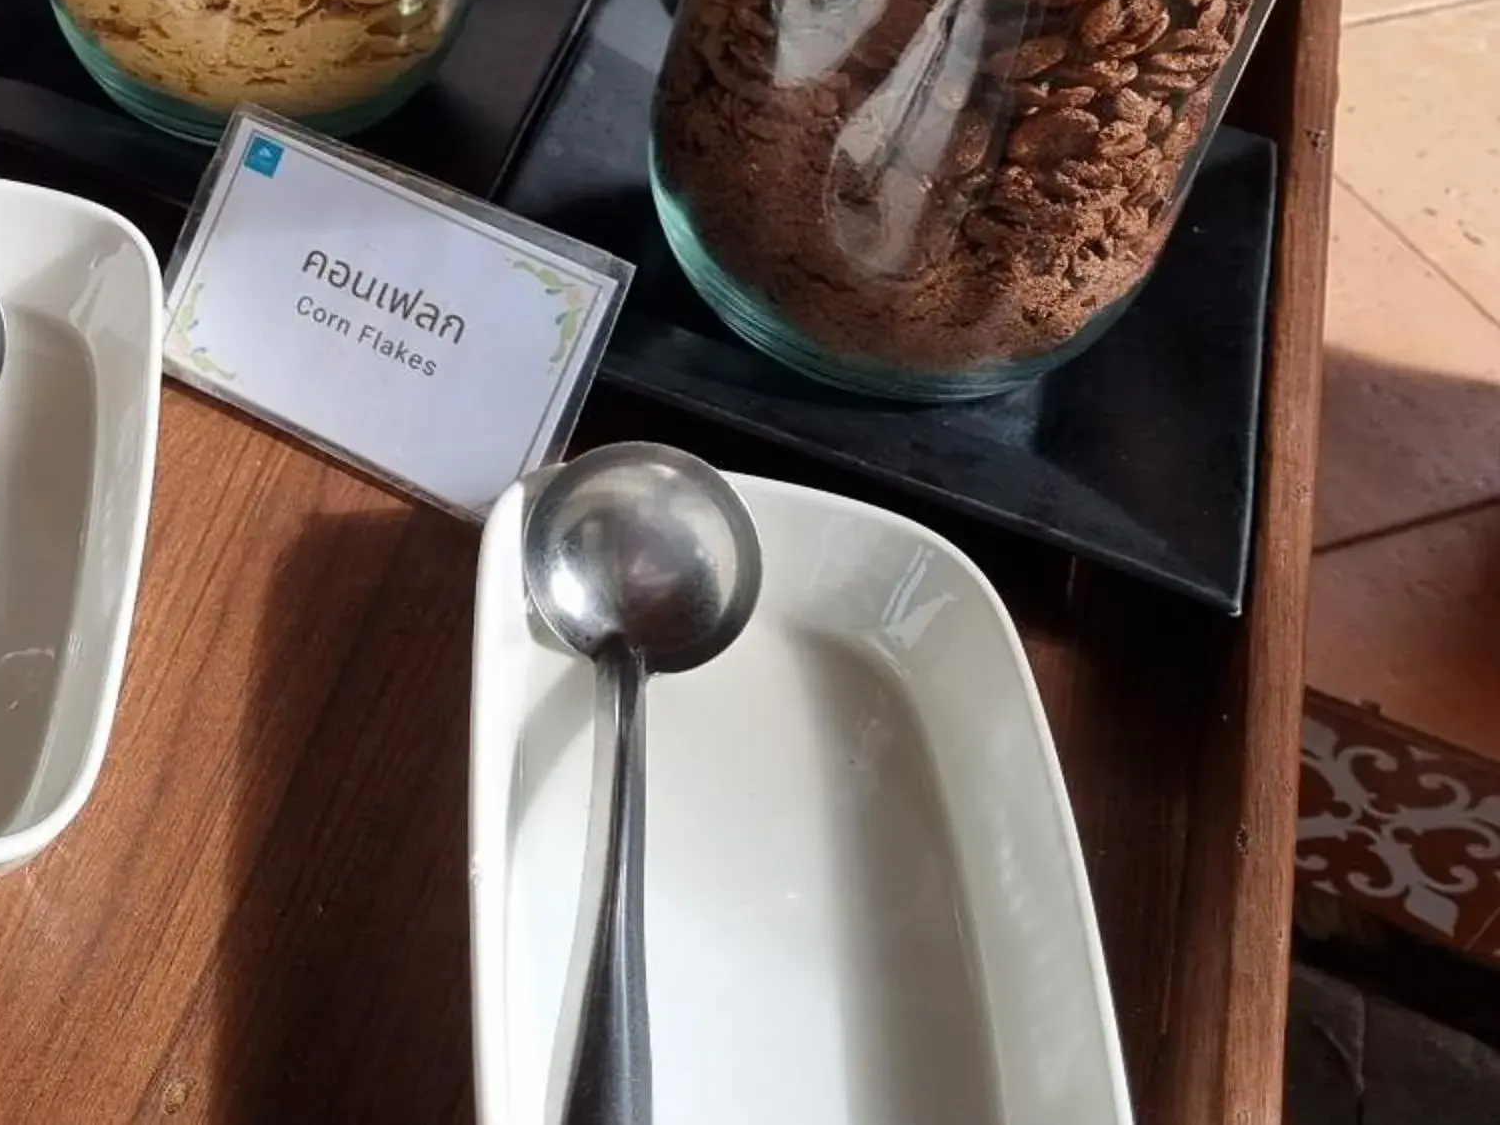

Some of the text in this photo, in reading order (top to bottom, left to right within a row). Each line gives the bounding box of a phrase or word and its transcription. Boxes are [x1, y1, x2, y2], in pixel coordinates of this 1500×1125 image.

[296, 296, 438, 376] Corn Flakes
[302, 250, 465, 345] คอนเฟลก
